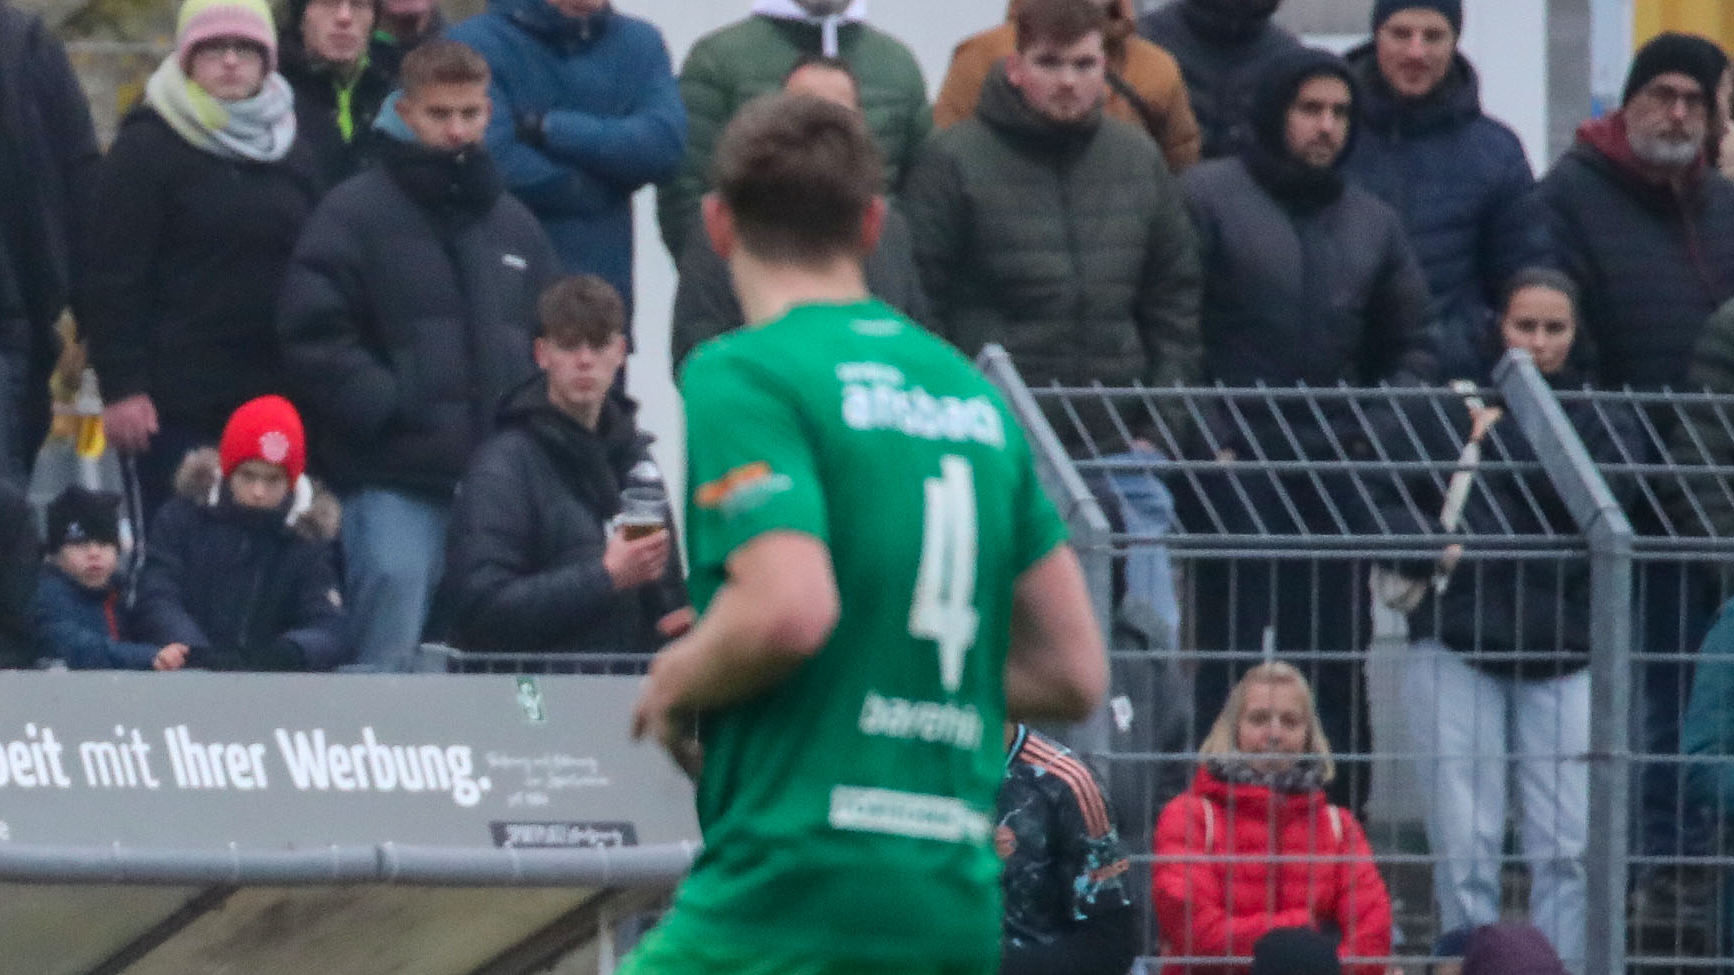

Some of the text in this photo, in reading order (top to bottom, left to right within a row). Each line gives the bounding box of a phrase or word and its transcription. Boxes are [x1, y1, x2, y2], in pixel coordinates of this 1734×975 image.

[909, 453, 979, 692] 4
[78, 723, 161, 789] mit
[164, 724, 268, 790] Ihrer
[274, 725, 493, 807] Werbung.
